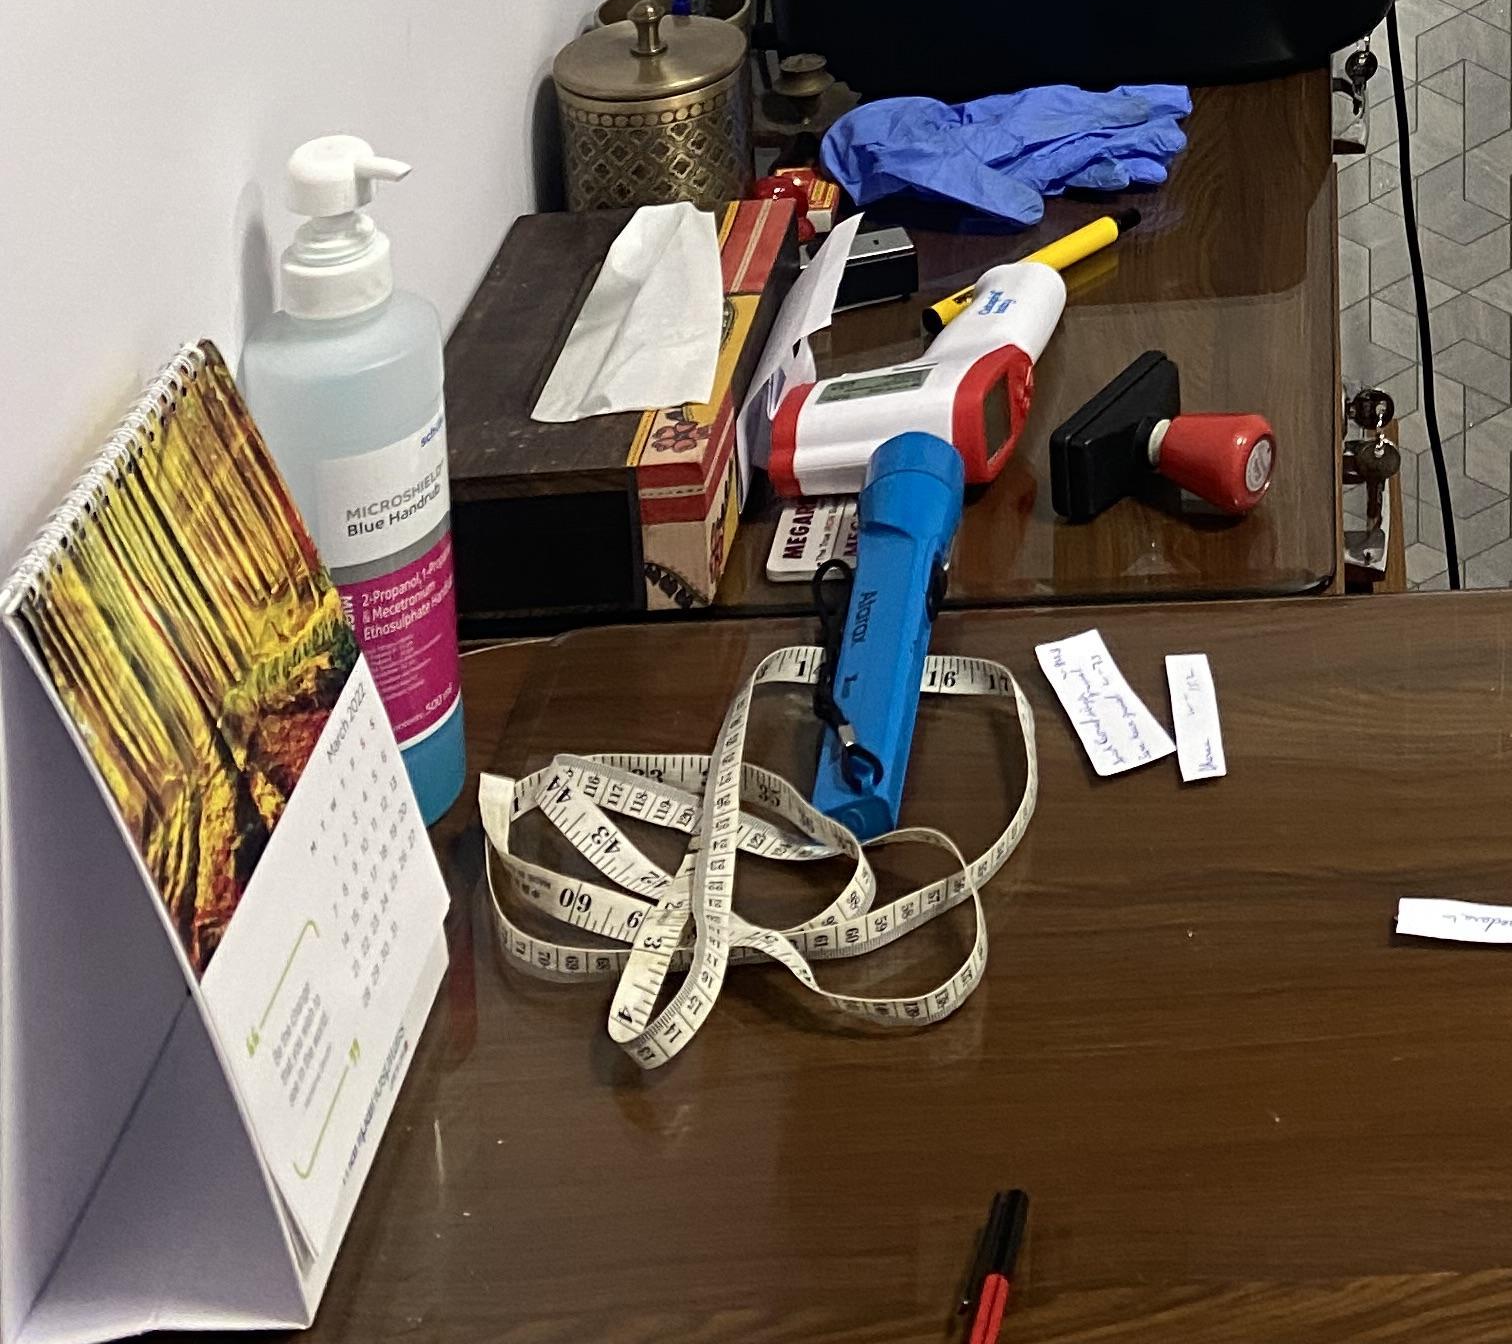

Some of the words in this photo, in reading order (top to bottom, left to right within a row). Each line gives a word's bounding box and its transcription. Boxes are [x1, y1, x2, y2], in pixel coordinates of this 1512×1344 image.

[346, 463, 443, 521] MICROSHIELD
[347, 519, 384, 537] Blue
[389, 483, 440, 525] Handrub
[929, 671, 957, 687] 16
[327, 719, 349, 764] March
[347, 683, 366, 721] 2022
[584, 774, 601, 798] 116
[607, 784, 624, 805] 117
[630, 792, 648, 813] 118
[654, 800, 672, 820] 119
[677, 807, 695, 827] 120
[591, 826, 622, 854] 43
[643, 936, 662, 951] 3
[701, 971, 714, 989] 16
[618, 1006, 633, 1023] 4
[687, 996, 703, 1015] 15
[663, 1024, 683, 1043] 14
